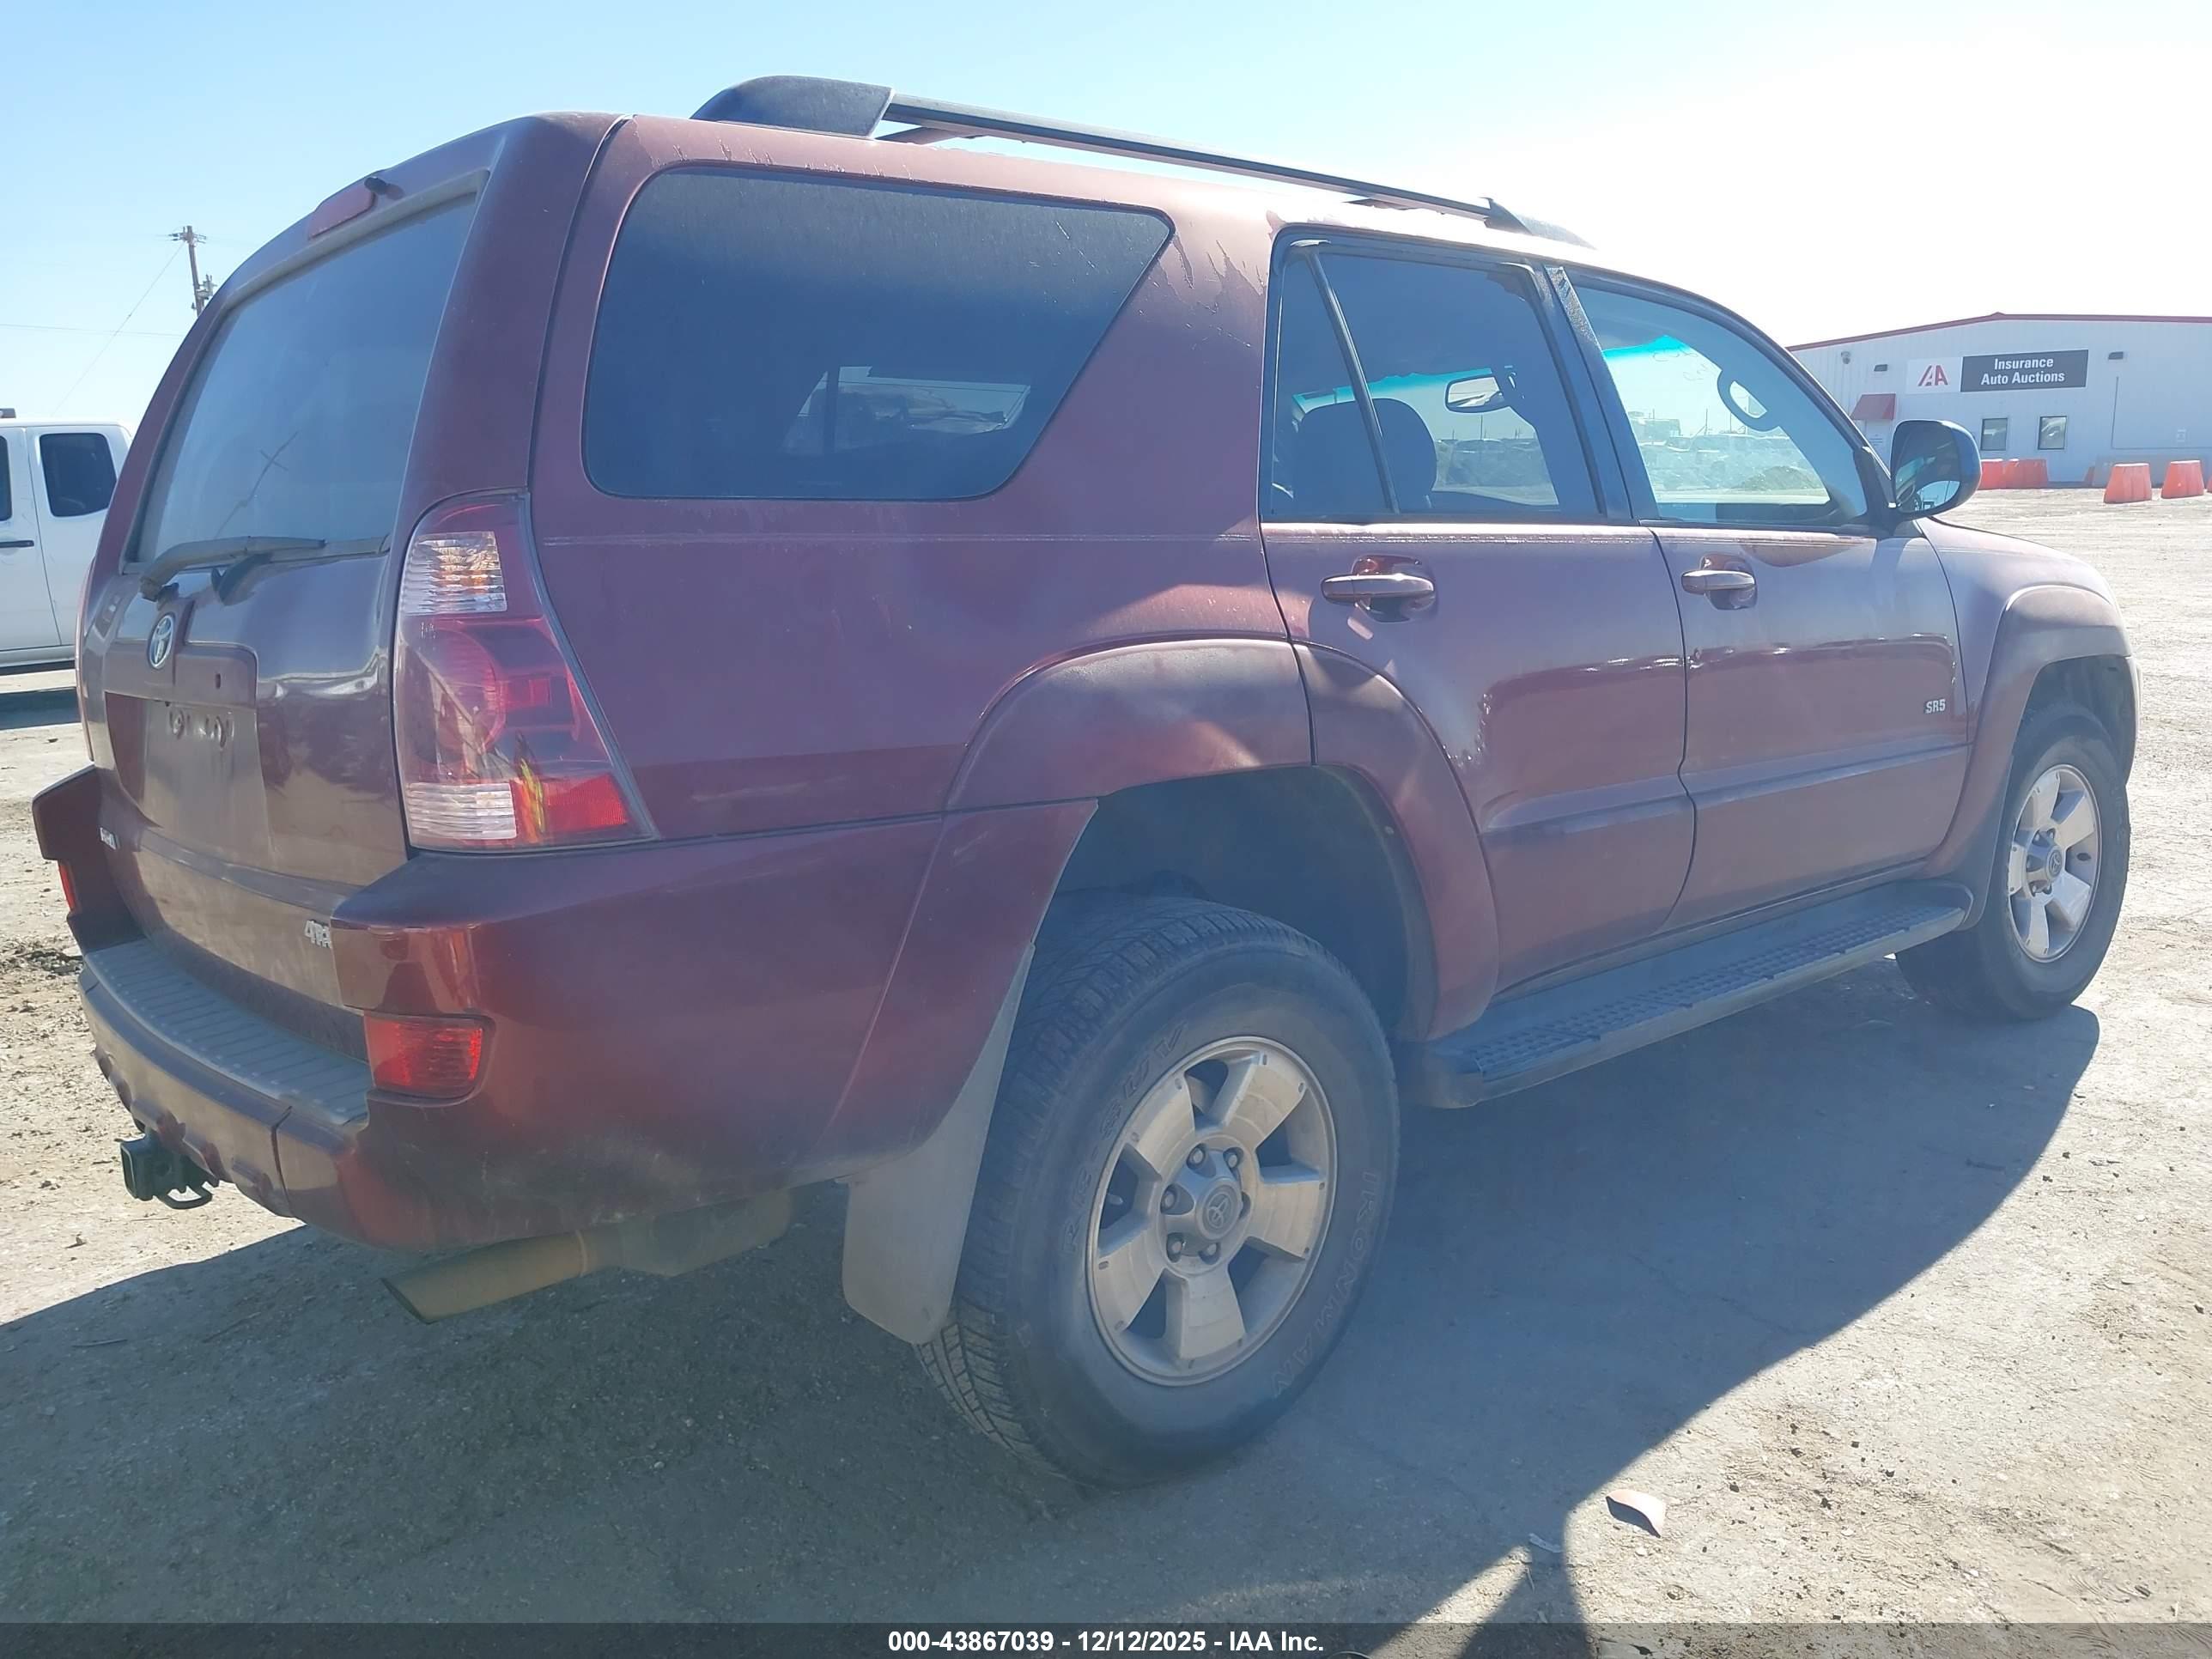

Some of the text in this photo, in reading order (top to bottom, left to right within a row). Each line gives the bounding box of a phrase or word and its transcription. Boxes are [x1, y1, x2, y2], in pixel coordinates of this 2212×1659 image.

[1994, 357, 2054, 370] Insurance
[1981, 370, 2065, 385] Auto Auctions
[1926, 698, 1946, 714] SR5
